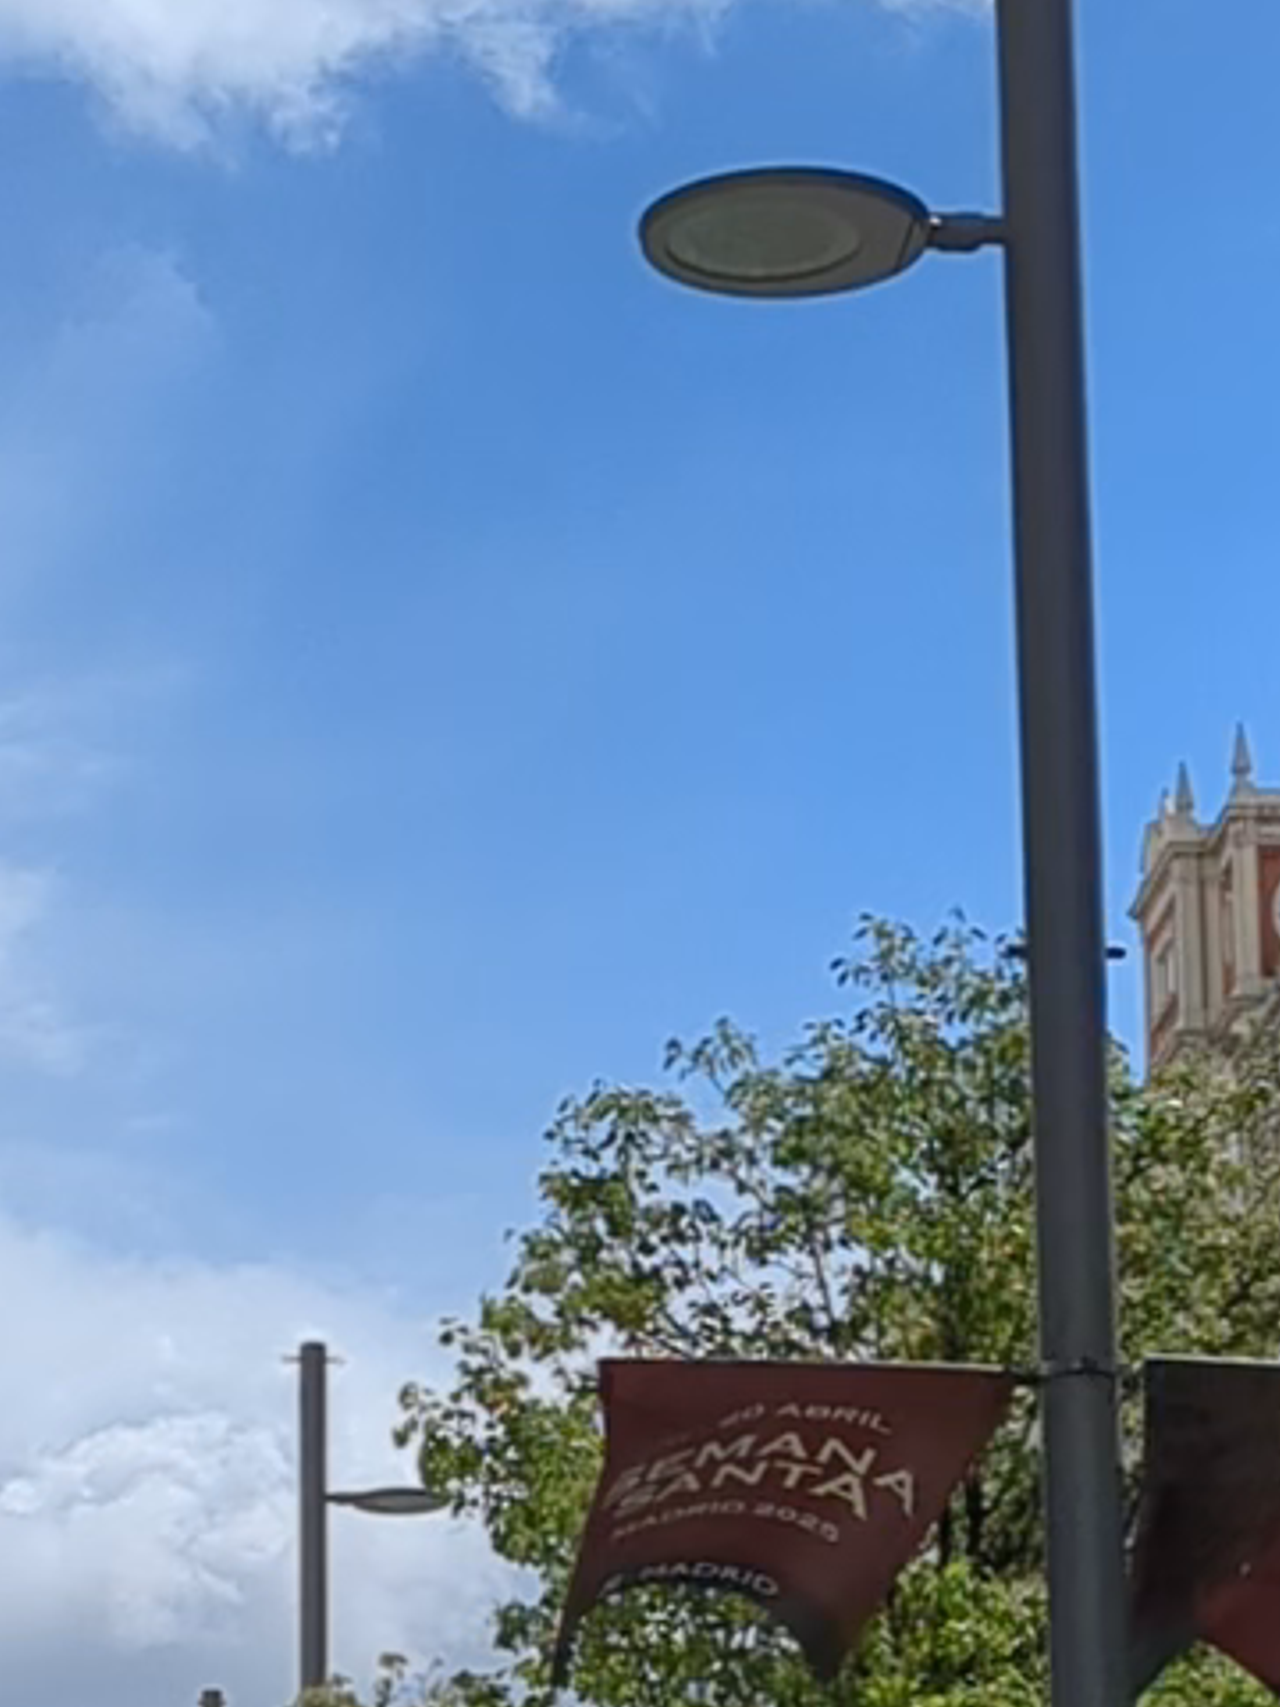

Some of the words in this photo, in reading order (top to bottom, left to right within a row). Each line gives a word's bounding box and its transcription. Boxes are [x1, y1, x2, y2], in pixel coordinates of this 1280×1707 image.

[776, 1402, 893, 1435] ABRIL
[604, 1431, 915, 1519] SEMANA
[612, 1461, 868, 1522] SANTA
[611, 1499, 746, 1541] MADRID
[752, 1503, 839, 1543] 2025
[640, 1561, 779, 1597] MADRID
